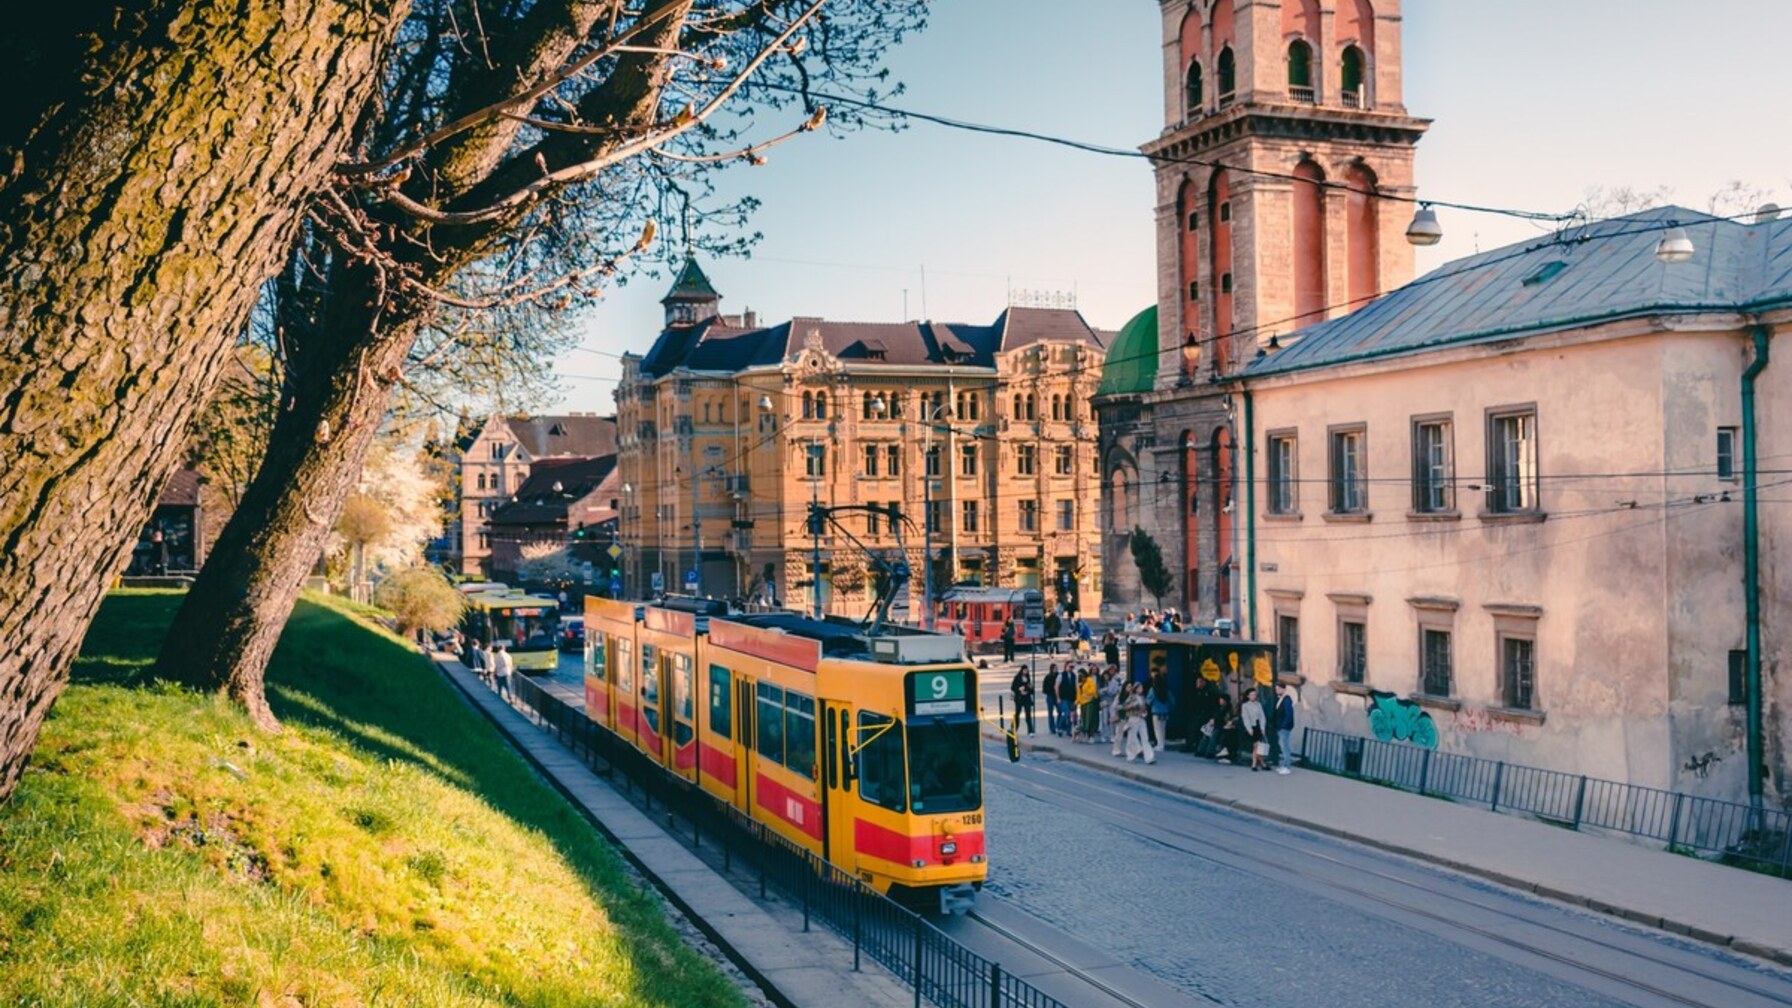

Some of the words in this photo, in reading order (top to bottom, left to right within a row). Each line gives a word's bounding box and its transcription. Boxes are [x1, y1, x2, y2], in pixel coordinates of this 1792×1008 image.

[688, 571, 696, 581] P
[931, 675, 948, 699] 9
[962, 814, 982, 825] 1260
